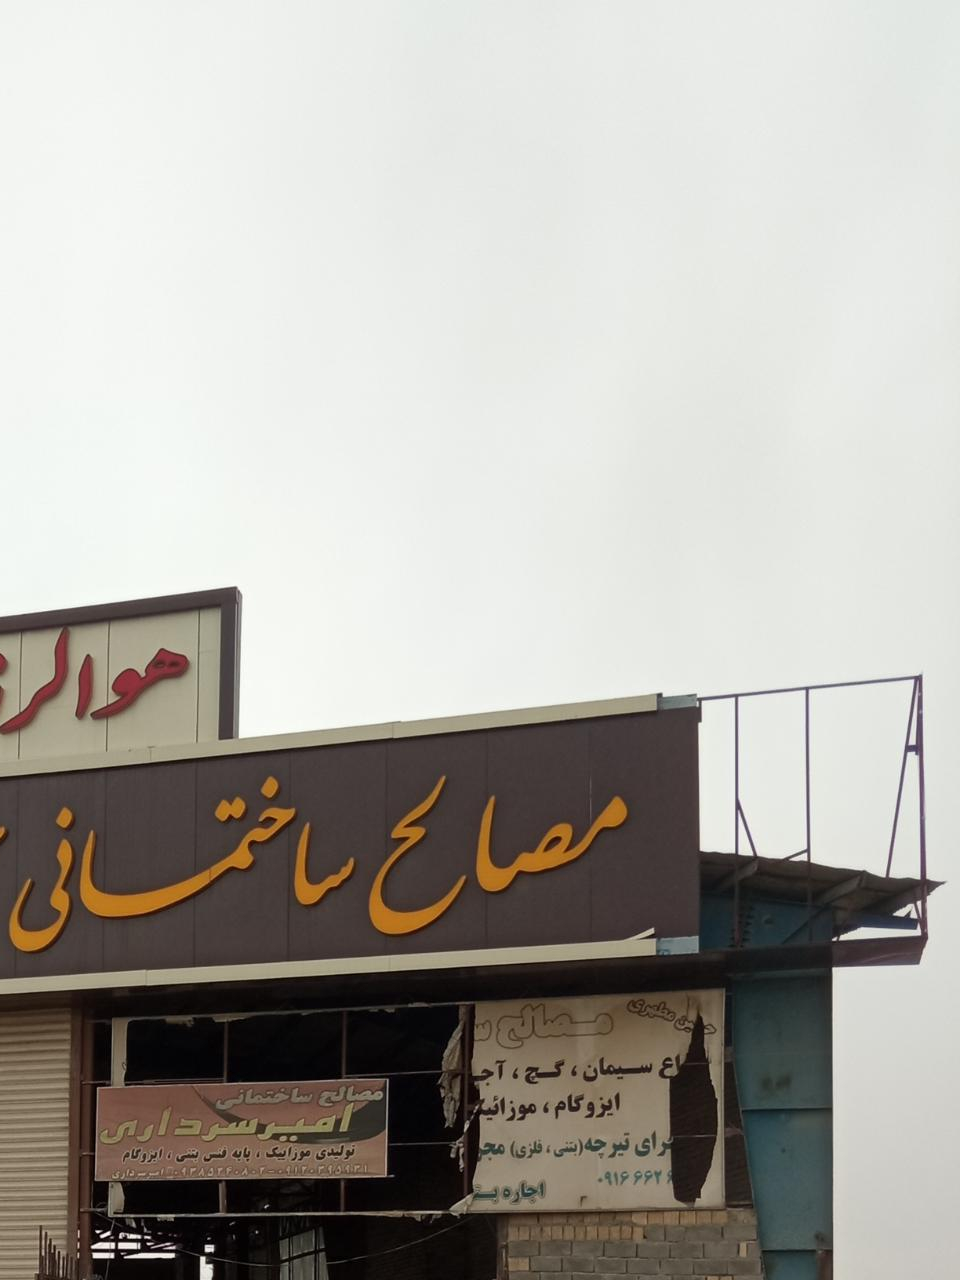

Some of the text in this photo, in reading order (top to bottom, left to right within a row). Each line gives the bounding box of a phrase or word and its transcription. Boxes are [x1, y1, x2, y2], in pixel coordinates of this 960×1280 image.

[8, 775, 356, 953] ساختمانی
[368, 774, 629, 936] مصالح
[524, 1059, 565, 1085] گچ
[582, 1057, 653, 1083] سیمان
[215, 1085, 385, 1111] مصالح ساختمانی
[315, 1144, 357, 1161] تولیدی
